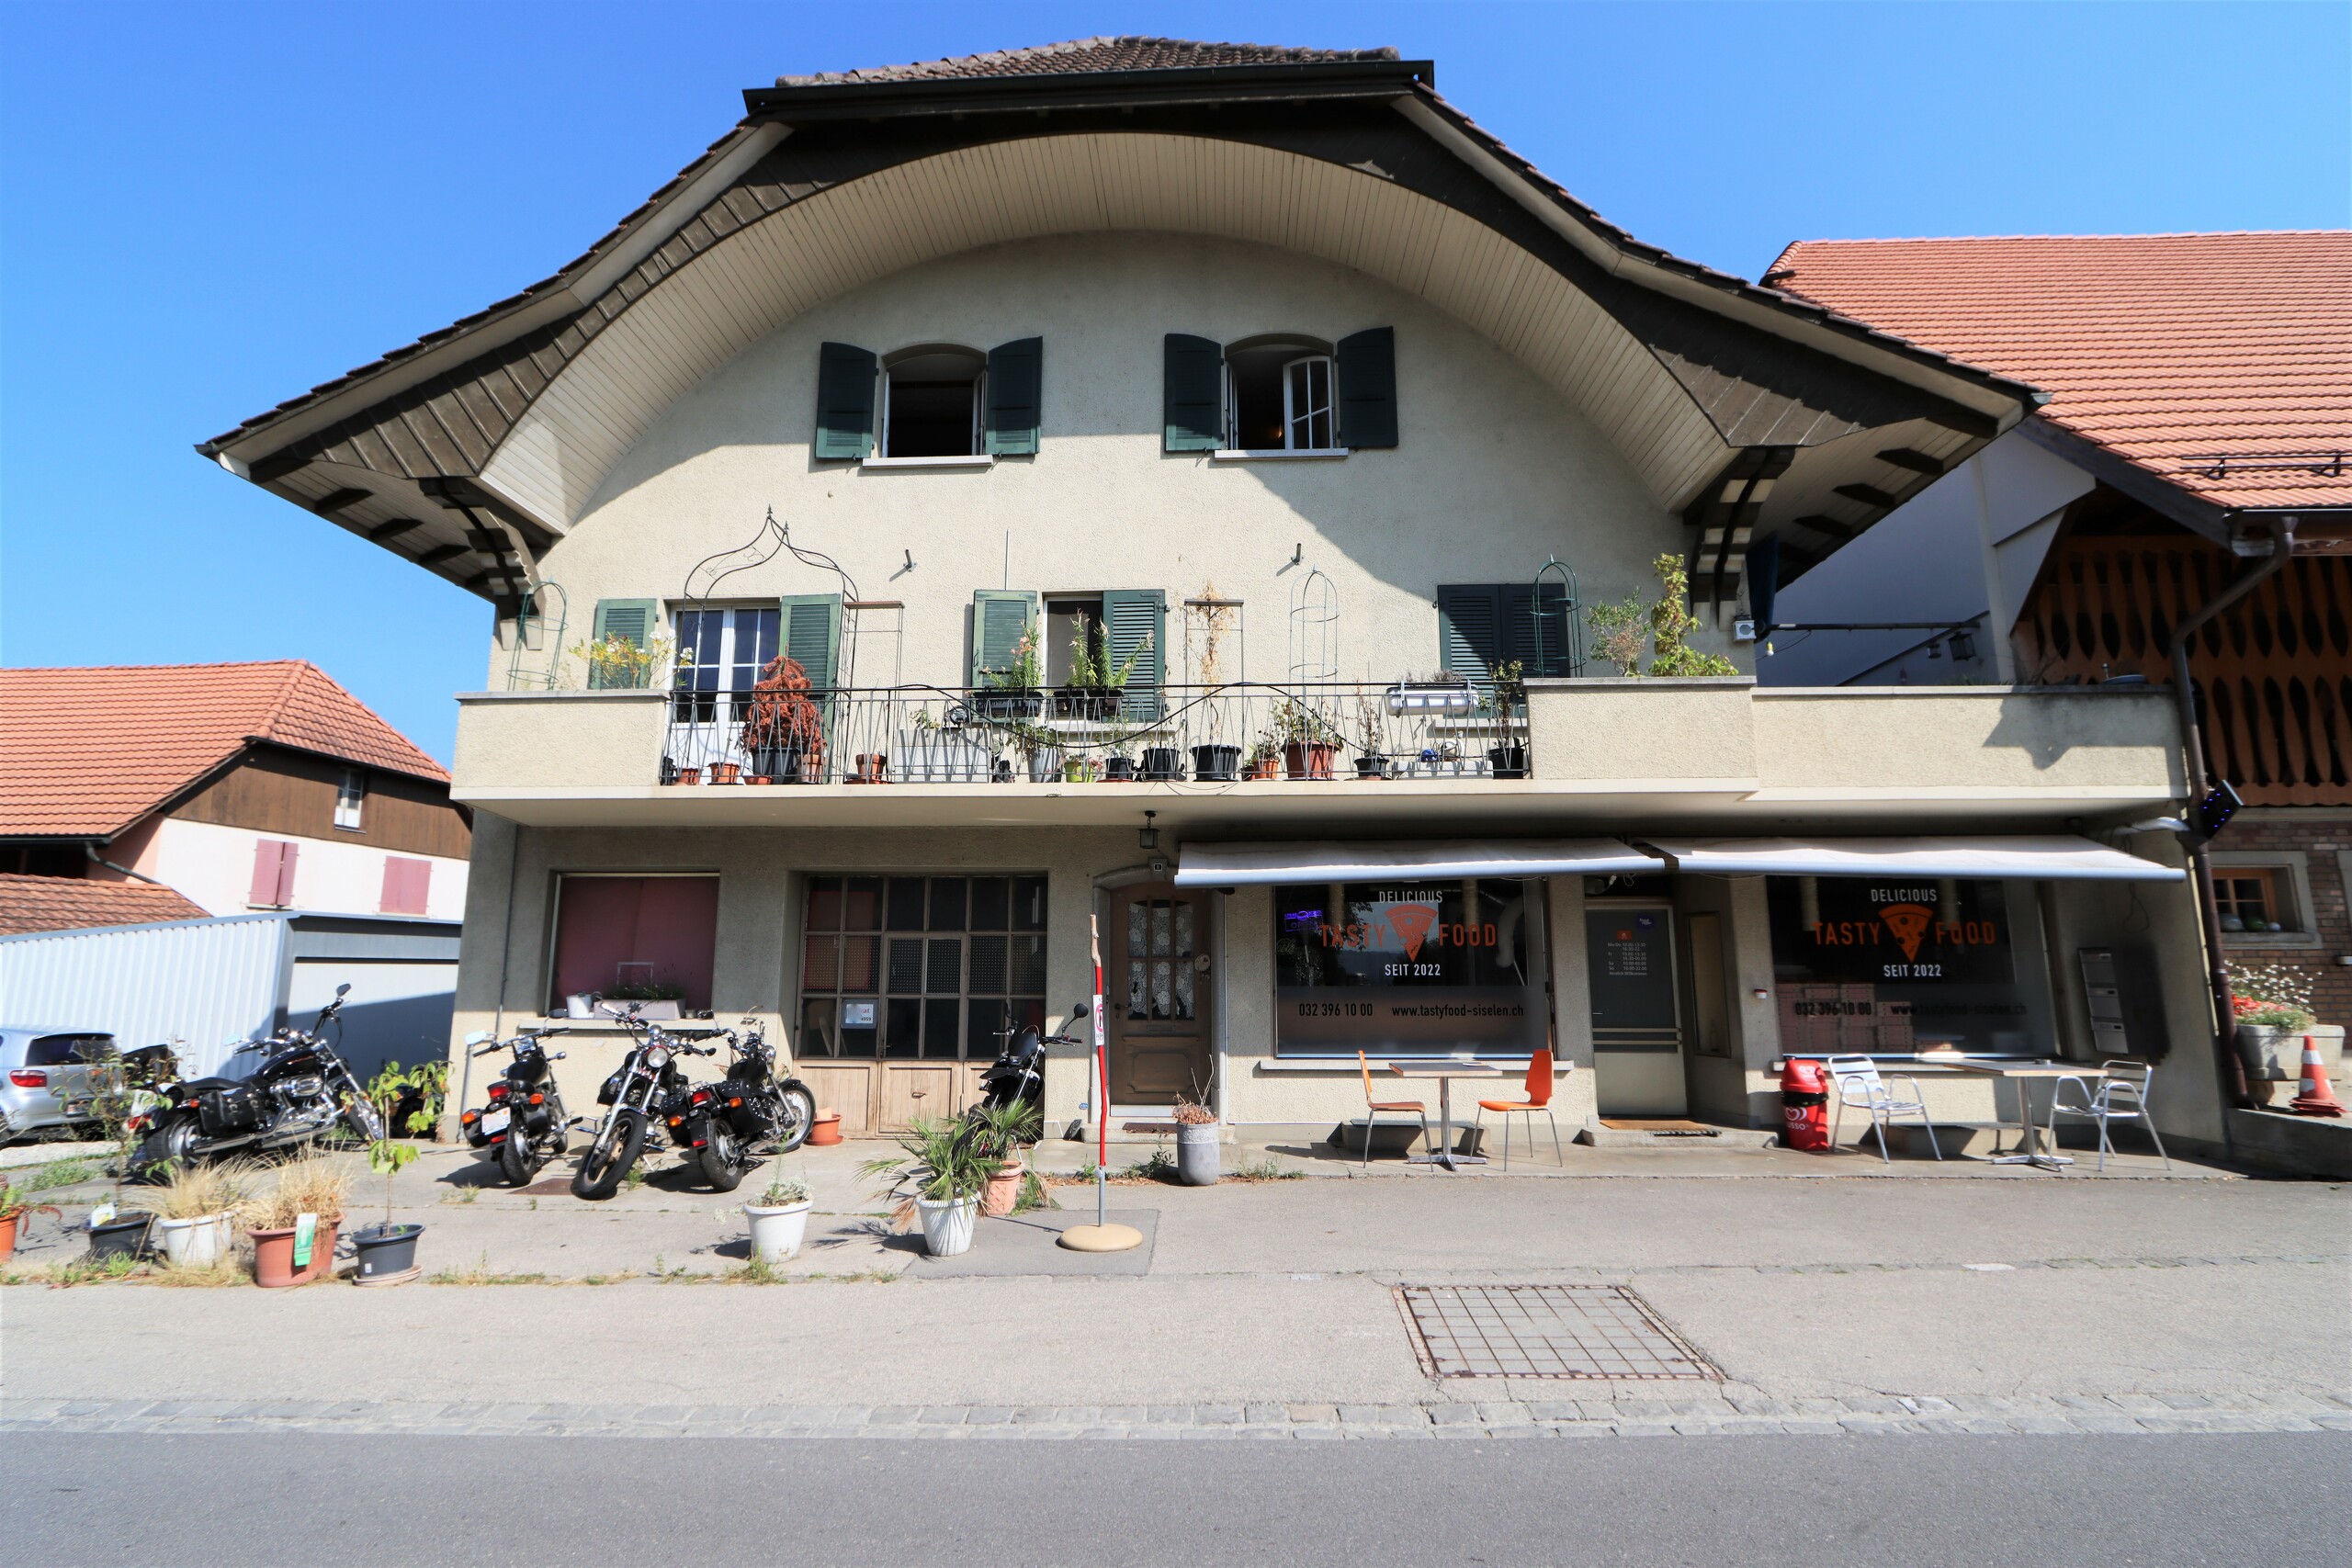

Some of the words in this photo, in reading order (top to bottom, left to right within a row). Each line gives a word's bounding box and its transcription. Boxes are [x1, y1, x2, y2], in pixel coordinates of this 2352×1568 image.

[1379, 890, 1443, 904] DELICIOUS
[1871, 889, 1938, 902] DELICIOUS
[1319, 924, 1385, 948] TASTY
[1439, 923, 1498, 947] FOOD
[1811, 921, 1881, 945] TASTY
[1935, 921, 1996, 945] FOOD
[1385, 964, 1408, 976] SEIT
[1414, 964, 1441, 976] 2022
[1883, 964, 1909, 977] SEIT
[1914, 964, 1941, 977] 2022
[1298, 1003, 1317, 1017] 032
[1321, 1003, 1340, 1017] 396
[1345, 1003, 1356, 1017] 10
[1360, 1003, 1374, 1017] 00
[1392, 1003, 1524, 1020] www.tastyfood-siselen.ch
[1794, 1002, 1815, 1016] 032
[1818, 1002, 1838, 1016] 396
[1841, 1002, 1855, 1015] 10
[1859, 1002, 1871, 1015] 00
[1786, 1122, 1806, 1130] USSO
